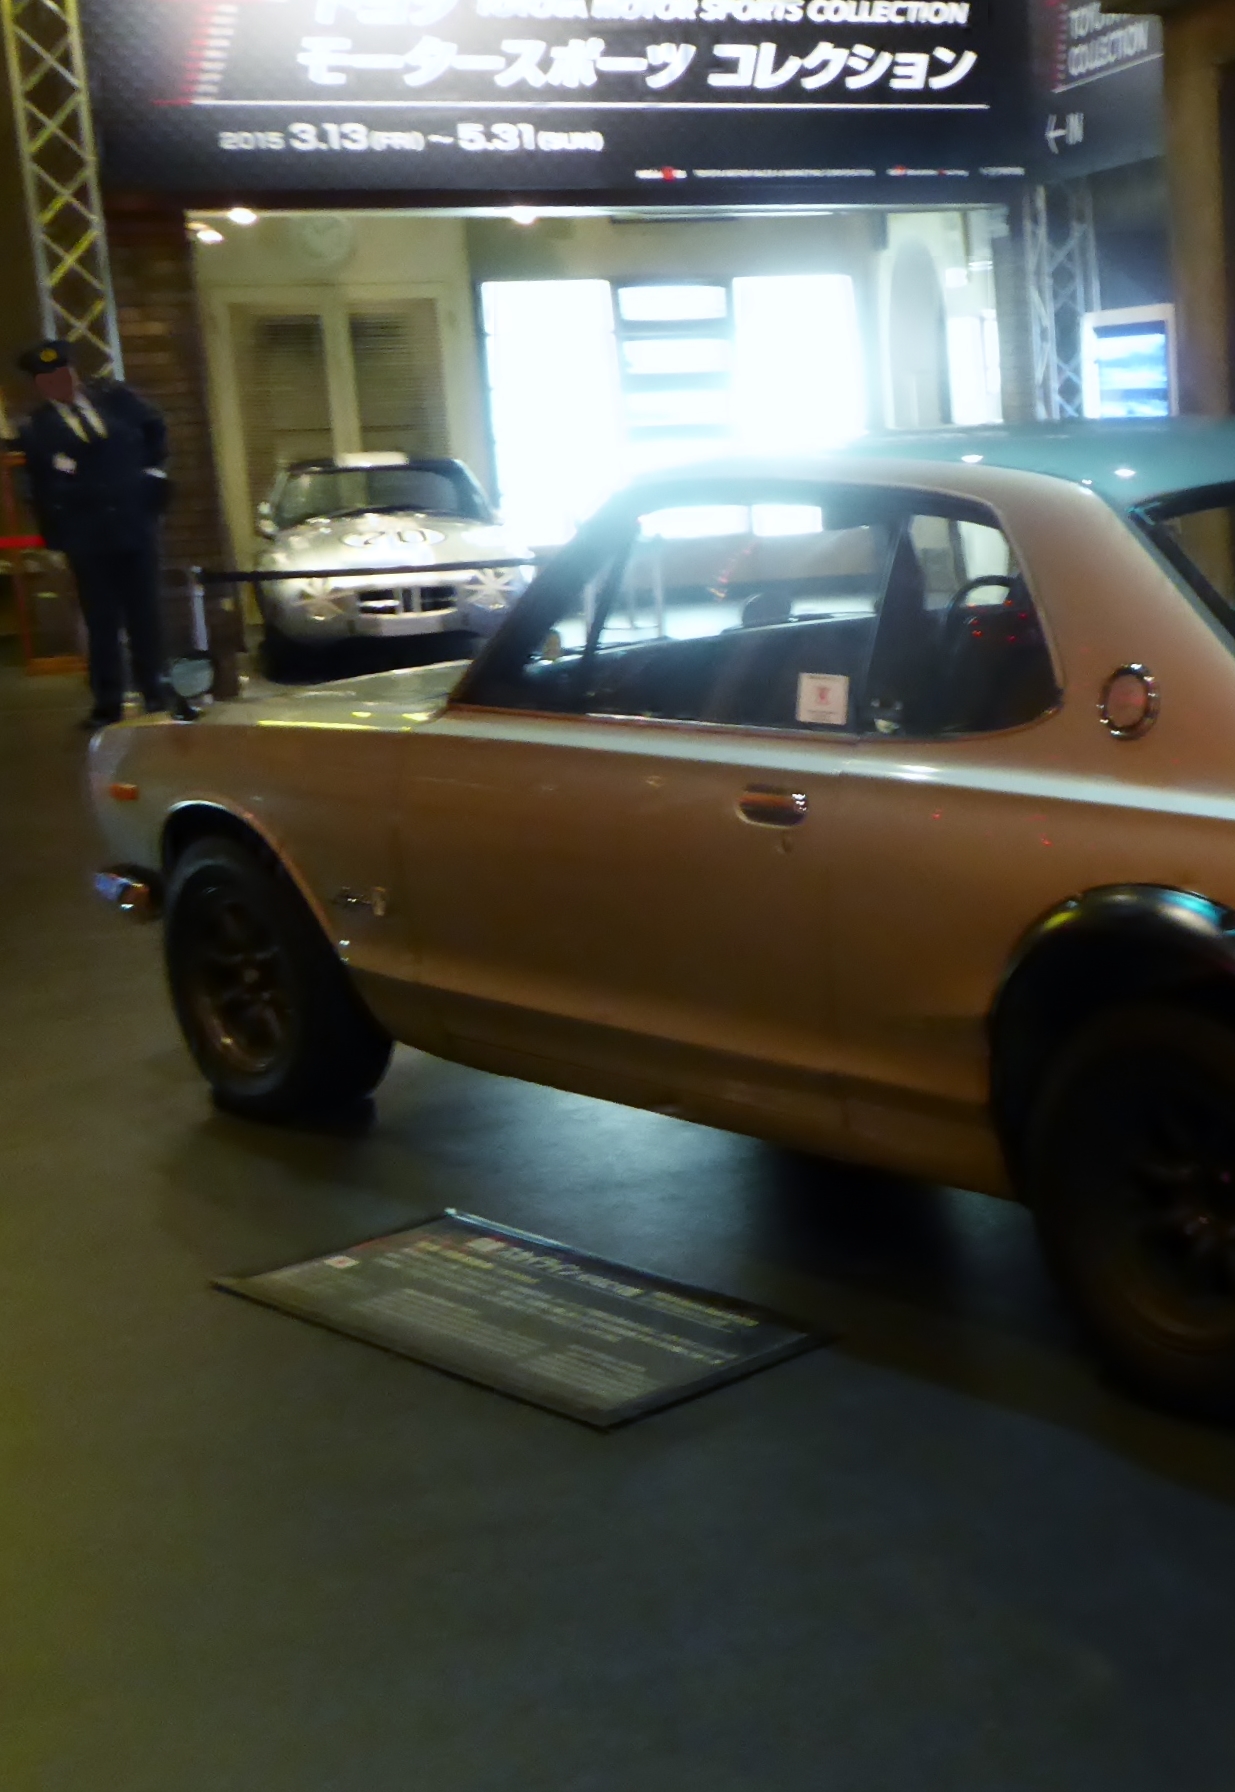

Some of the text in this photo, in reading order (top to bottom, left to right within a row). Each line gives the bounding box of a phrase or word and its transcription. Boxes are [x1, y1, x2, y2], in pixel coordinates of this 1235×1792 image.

[806, 1, 970, 25] COLLECTION
[298, 36, 978, 90] モータースポーツ コレクション
[218, 131, 285, 150] 2015
